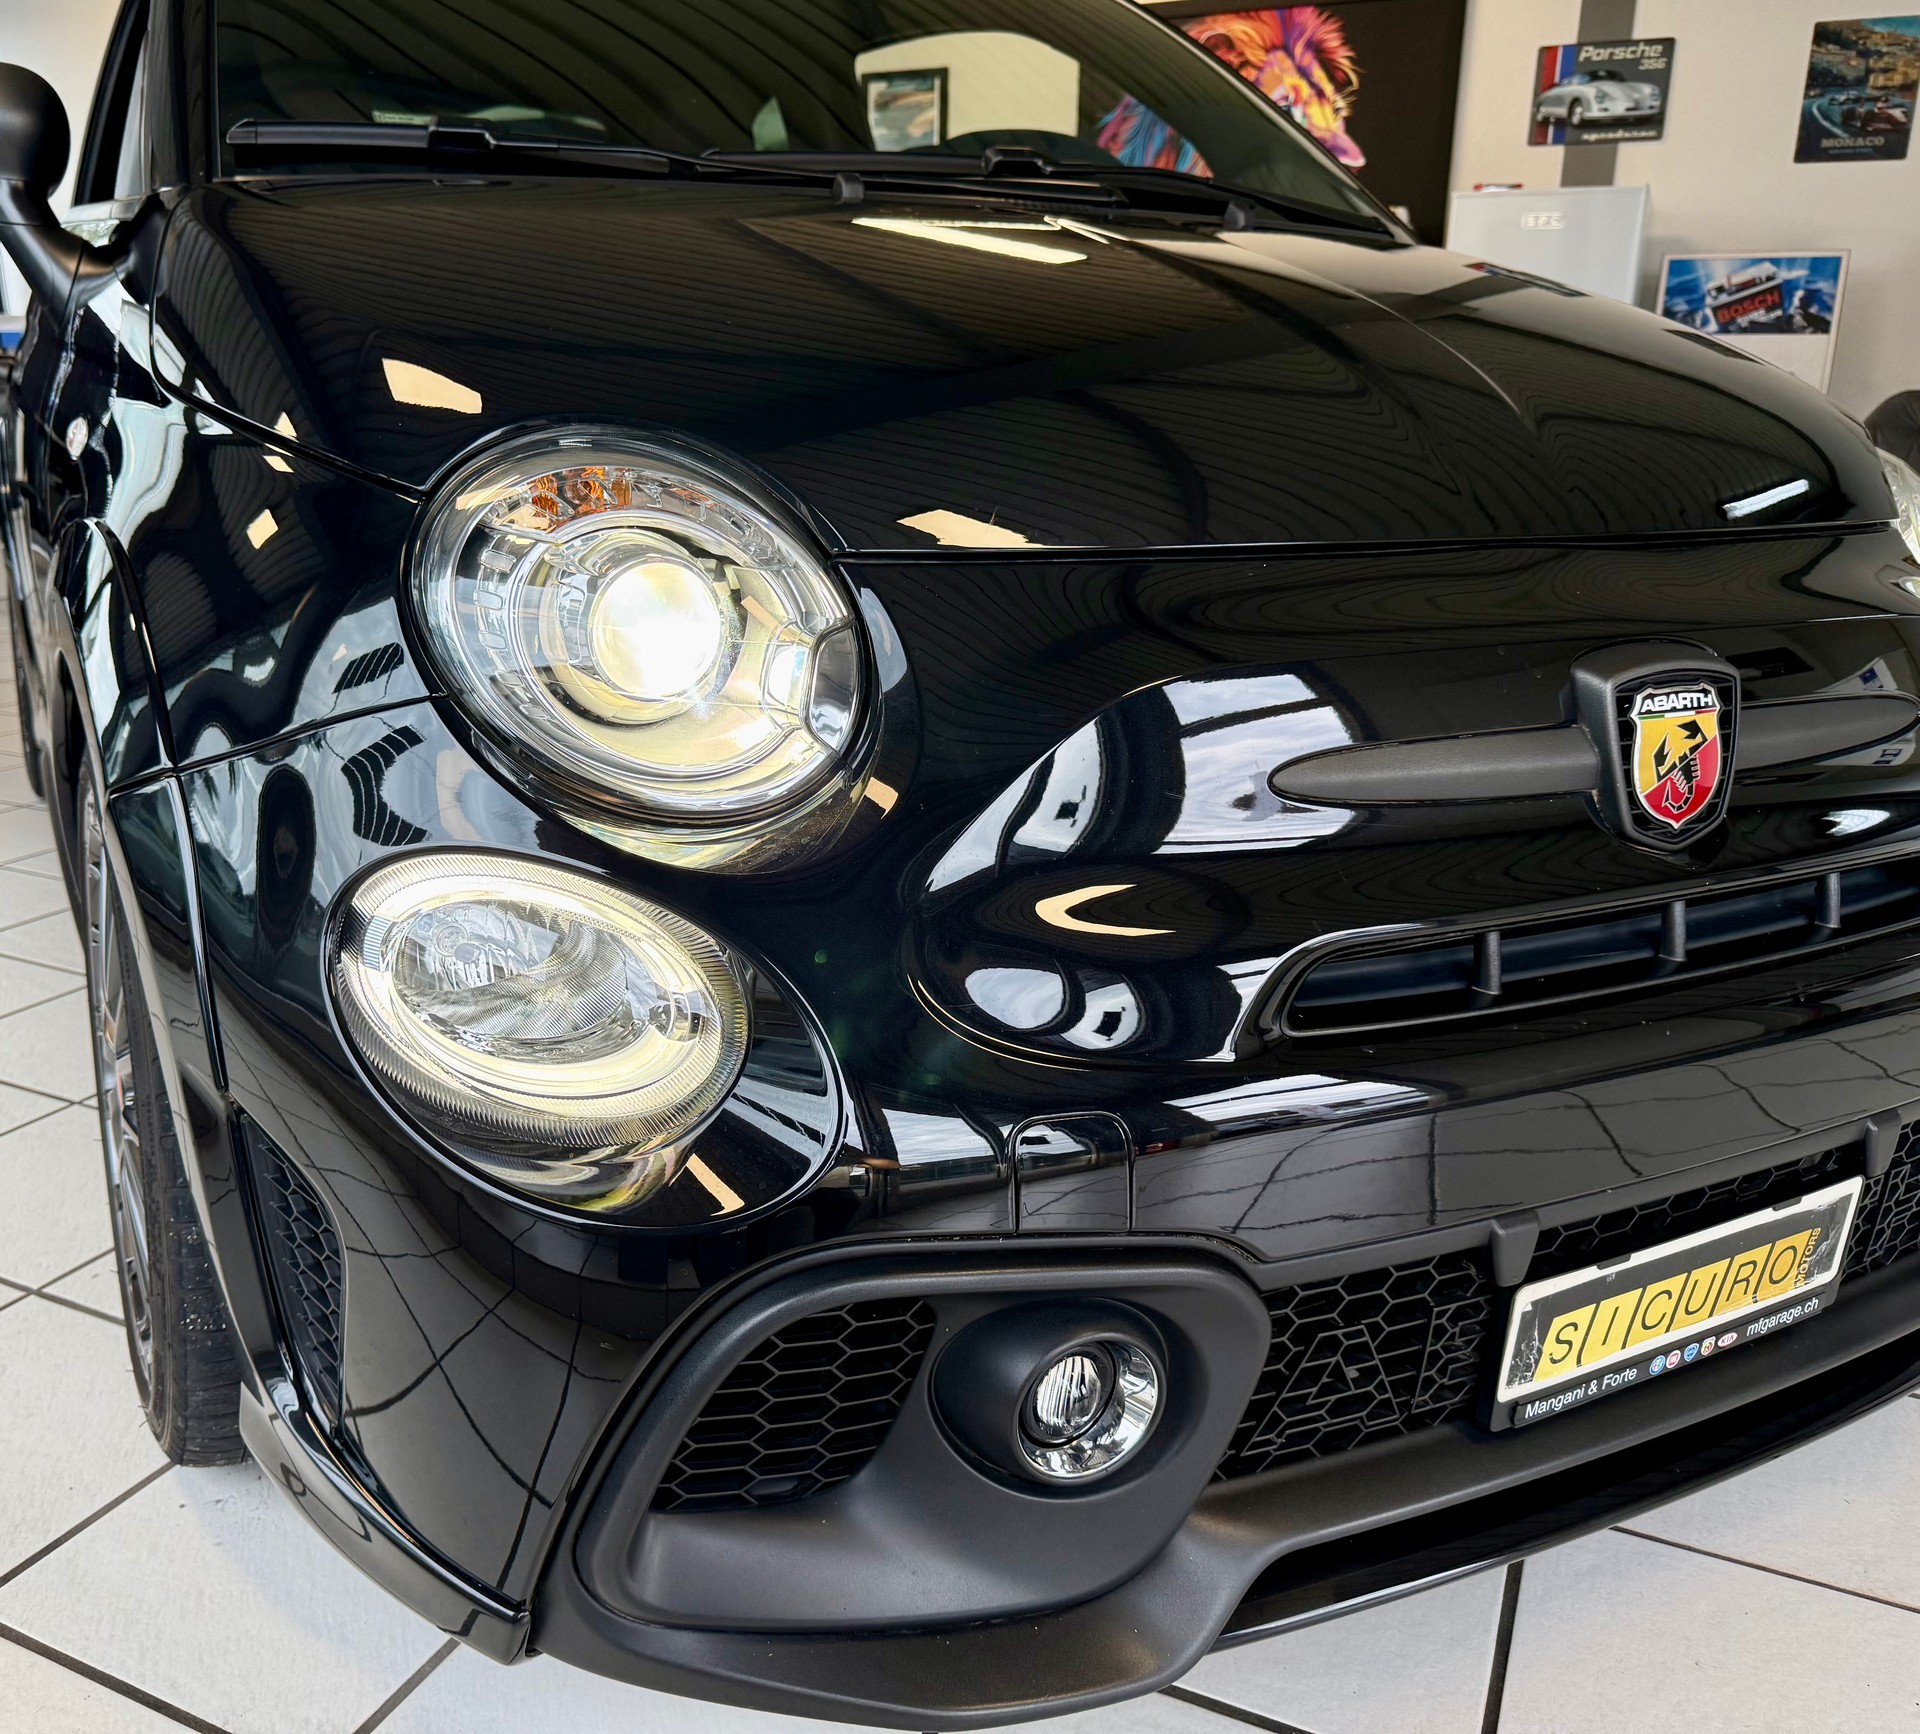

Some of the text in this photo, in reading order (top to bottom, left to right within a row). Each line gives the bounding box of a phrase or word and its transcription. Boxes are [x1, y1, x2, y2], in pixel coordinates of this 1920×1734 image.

[1578, 41, 1663, 62] Porsche
[1820, 136, 1885, 149] MONACO
[1717, 289, 1780, 324] BOSCH
[1640, 692, 1713, 713] ABARTH
[1794, 1227, 1821, 1288] MOTORS
[1549, 1245, 1798, 1365] SICURO
[1746, 1297, 1820, 1337] mfgarage.ch
[1525, 1368, 1638, 1419] Mangani & Forte
